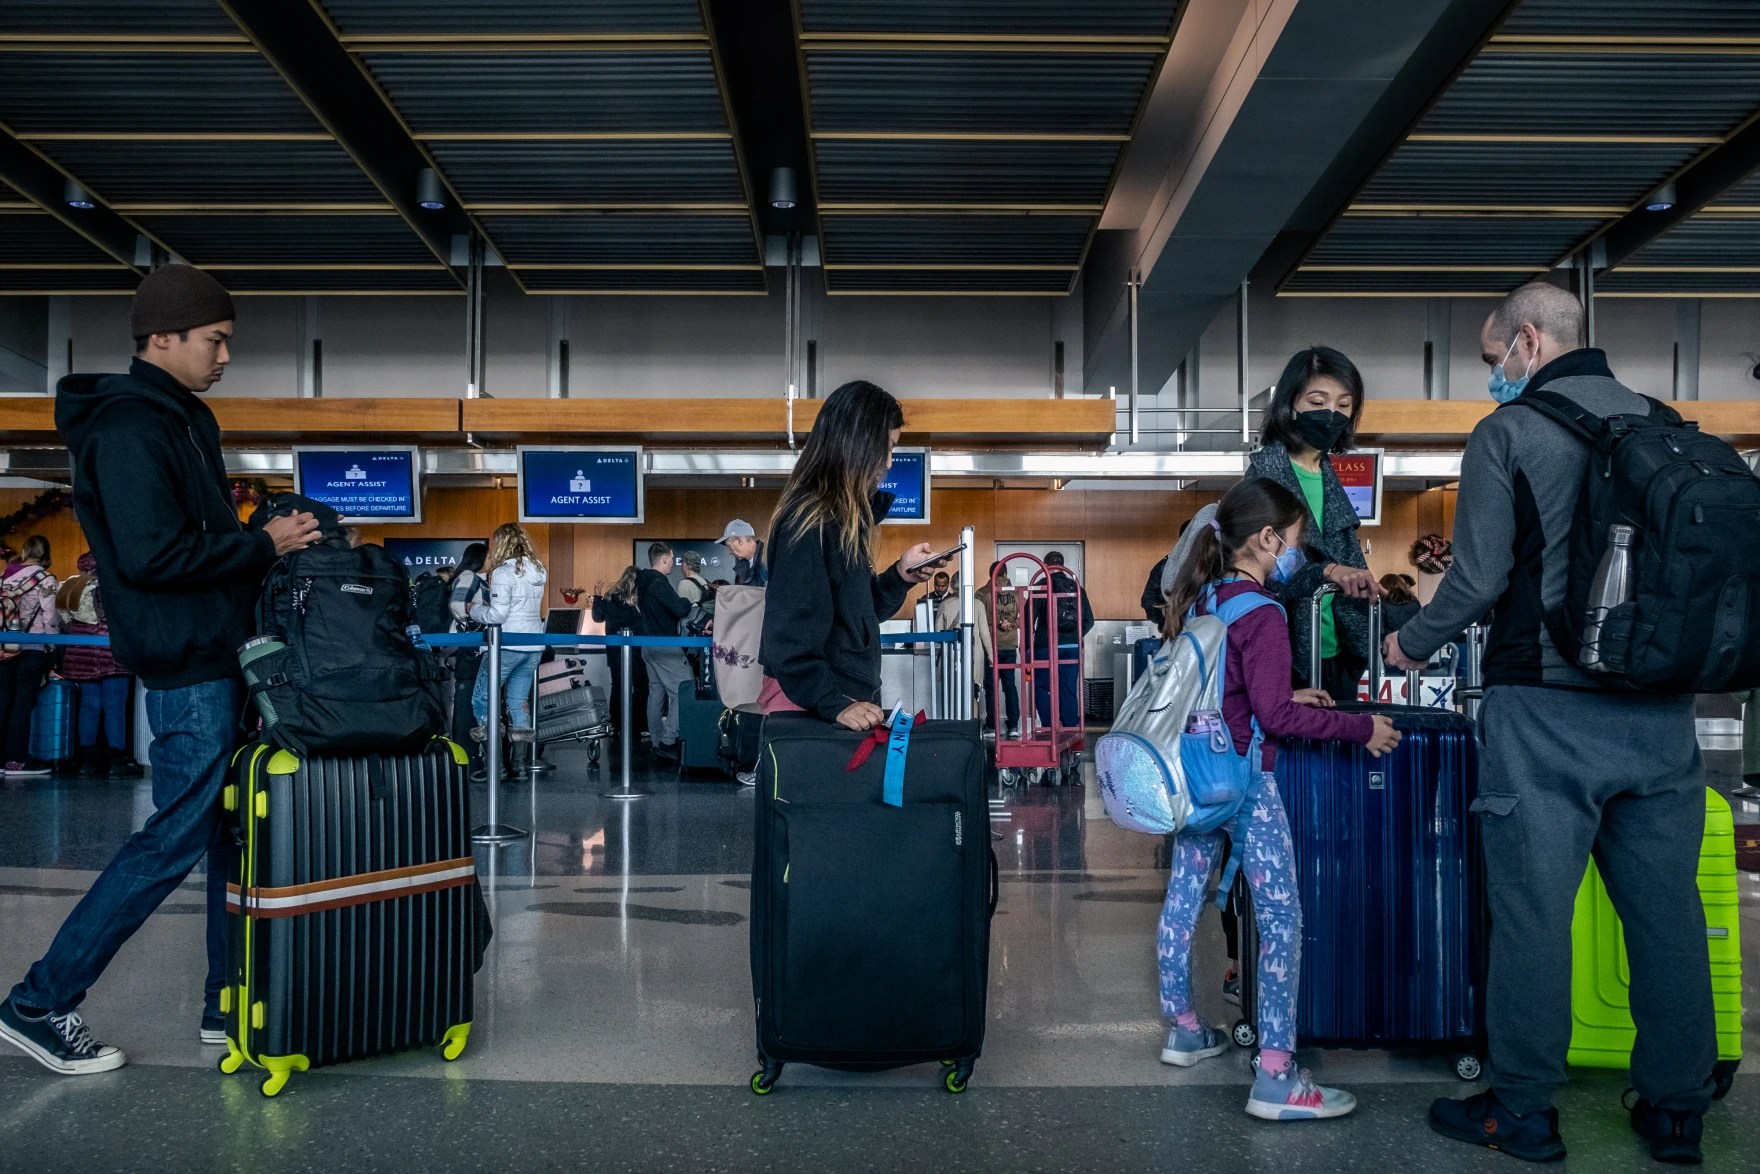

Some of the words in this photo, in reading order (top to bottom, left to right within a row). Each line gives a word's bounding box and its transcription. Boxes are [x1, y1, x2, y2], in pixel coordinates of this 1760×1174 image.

[551, 496, 580, 504] AGENT
[582, 496, 611, 504] ASSIST
[415, 556, 456, 565] DELTA
